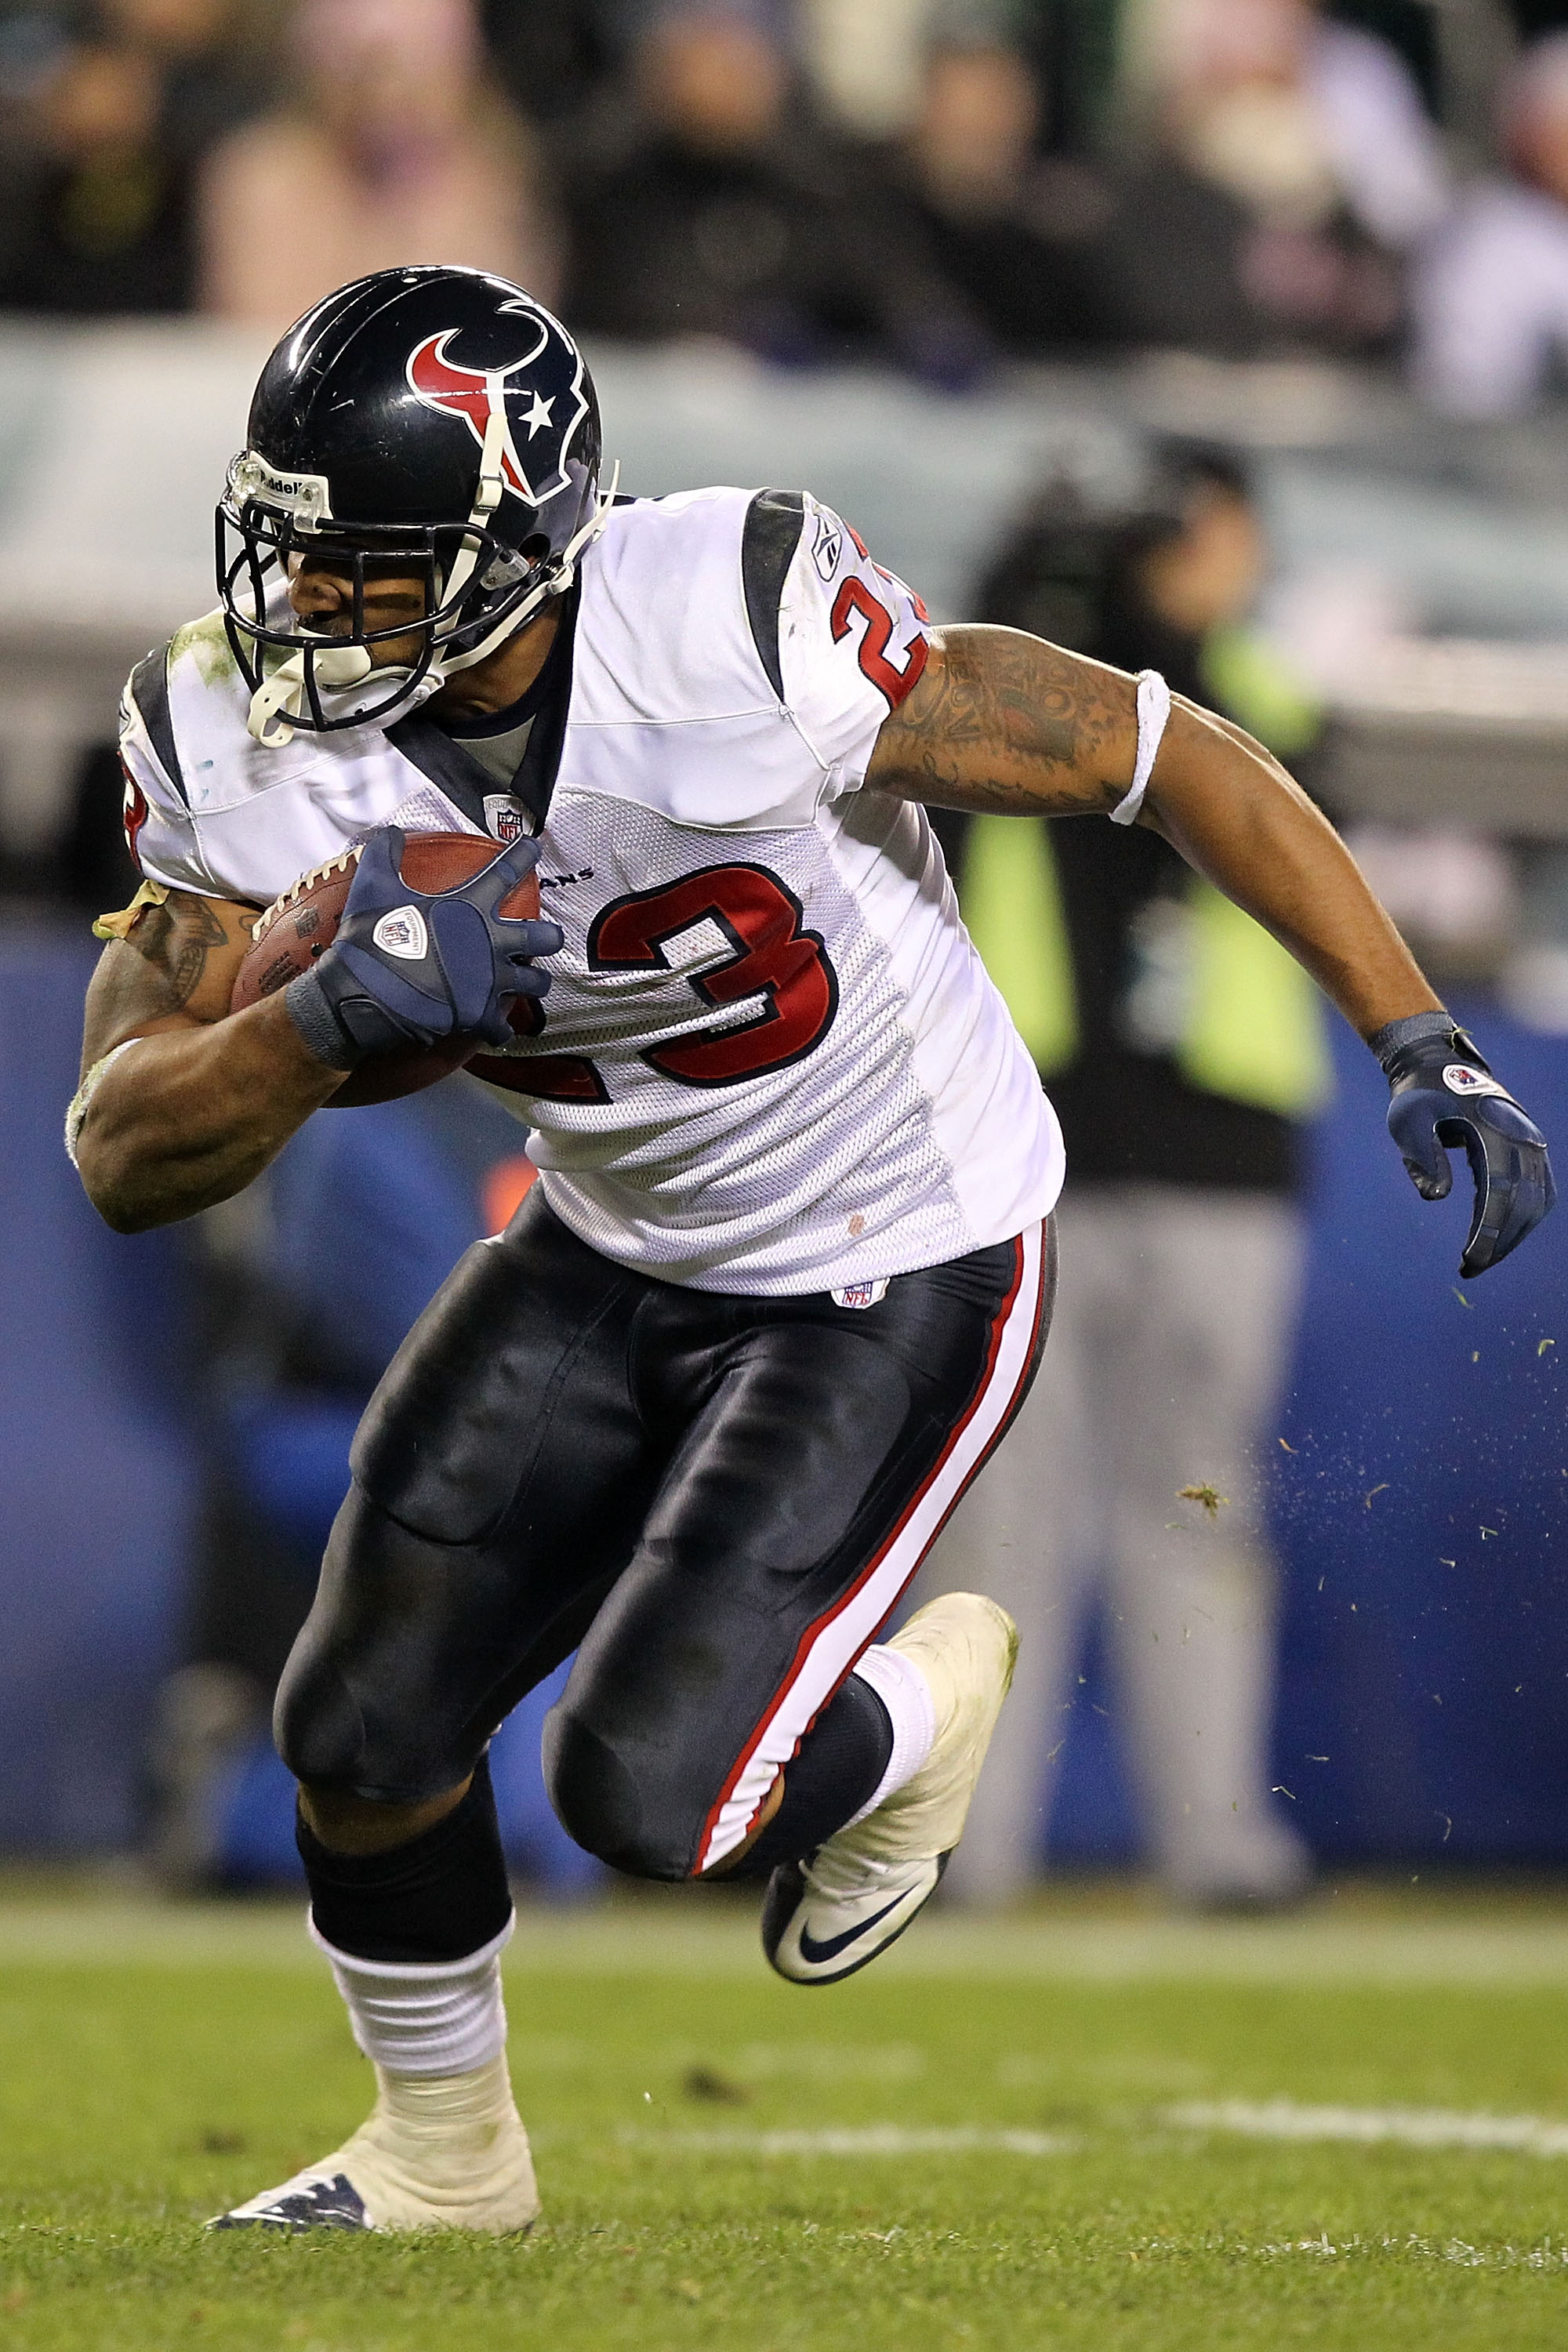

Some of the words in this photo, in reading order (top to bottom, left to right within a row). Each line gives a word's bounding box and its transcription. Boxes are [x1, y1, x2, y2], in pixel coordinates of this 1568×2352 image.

[260, 469, 303, 495] ddel
[499, 823, 520, 840] NFL
[539, 867, 593, 890] ANS
[384, 925, 401, 945] NFL
[405, 912, 419, 951] EQUIPMENT
[844, 1291, 869, 1305] NFL
